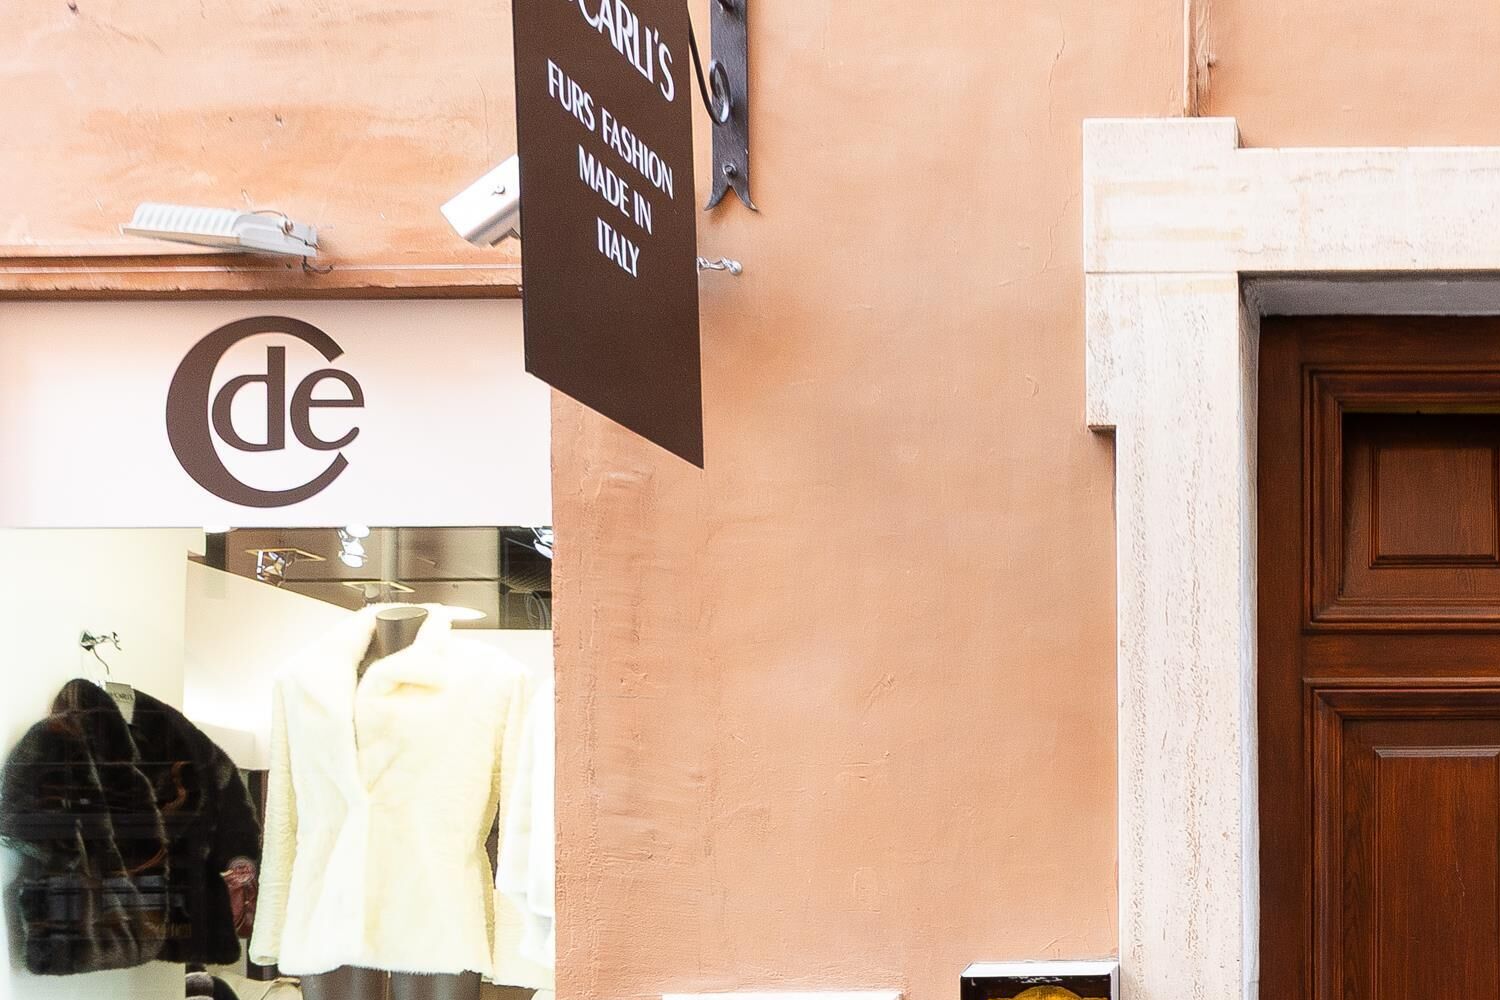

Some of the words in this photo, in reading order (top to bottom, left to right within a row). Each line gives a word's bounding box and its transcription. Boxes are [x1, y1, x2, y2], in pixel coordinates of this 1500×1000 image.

[547, 58, 597, 133] FURS
[601, 107, 675, 200] FASHION
[578, 144, 630, 218] MADE
[633, 189, 653, 235] IN
[597, 216, 640, 279] ITALY
